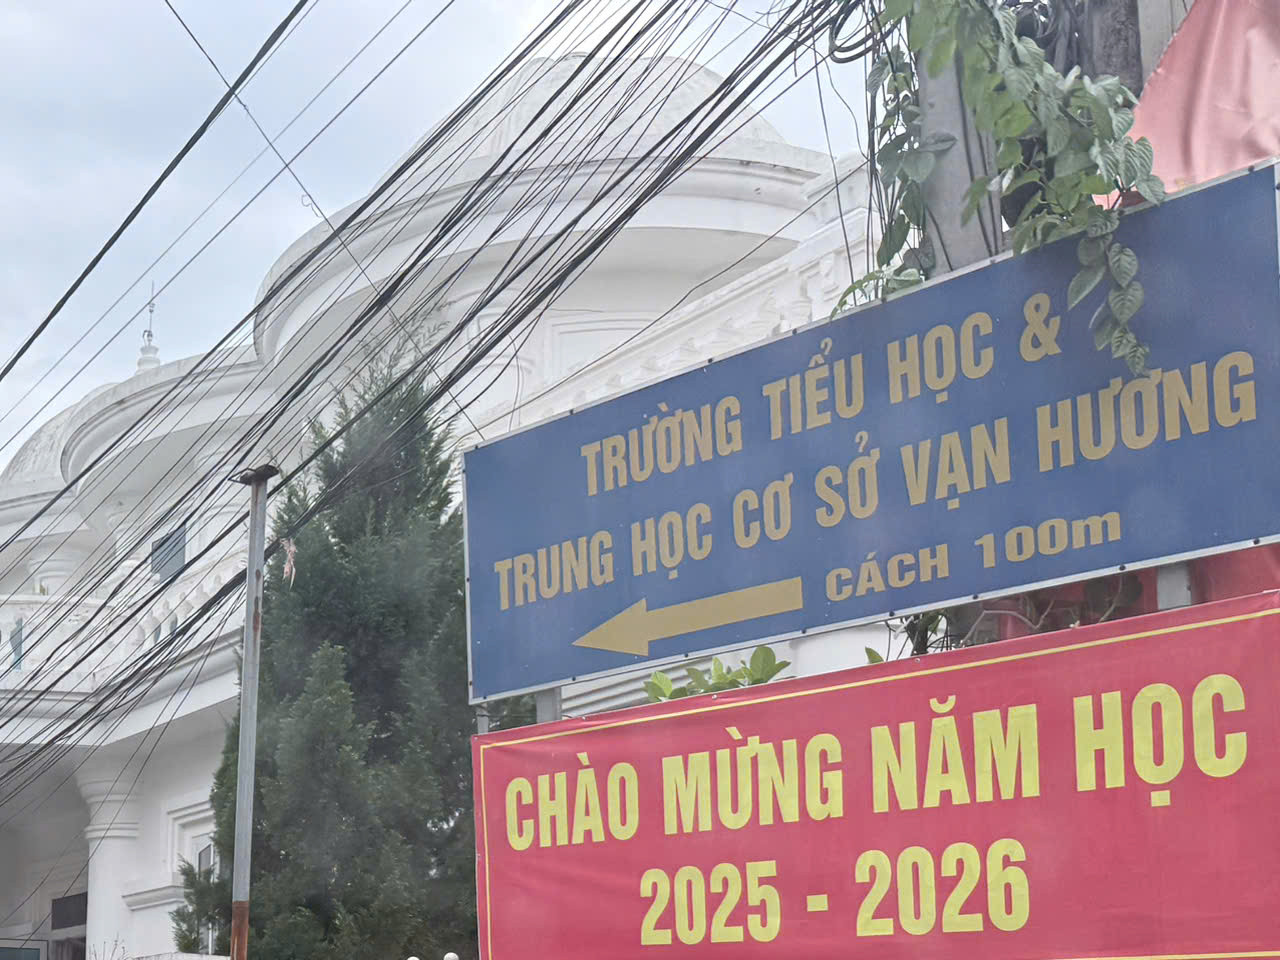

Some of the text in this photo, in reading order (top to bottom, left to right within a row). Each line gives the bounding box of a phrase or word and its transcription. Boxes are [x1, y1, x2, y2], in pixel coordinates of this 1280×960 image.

[494, 350, 1258, 611] TRUNG HỌC CƠ SỞ VẠN HƯƠNG
[581, 292, 1061, 497] TRƯỜNG TIỂU HỌC &
[826, 511, 1122, 601] CÁCH 100m
[506, 673, 1249, 851] CHÀO MỪNG NĂM HỌC
[640, 838, 1030, 946] 2025 - 2026
